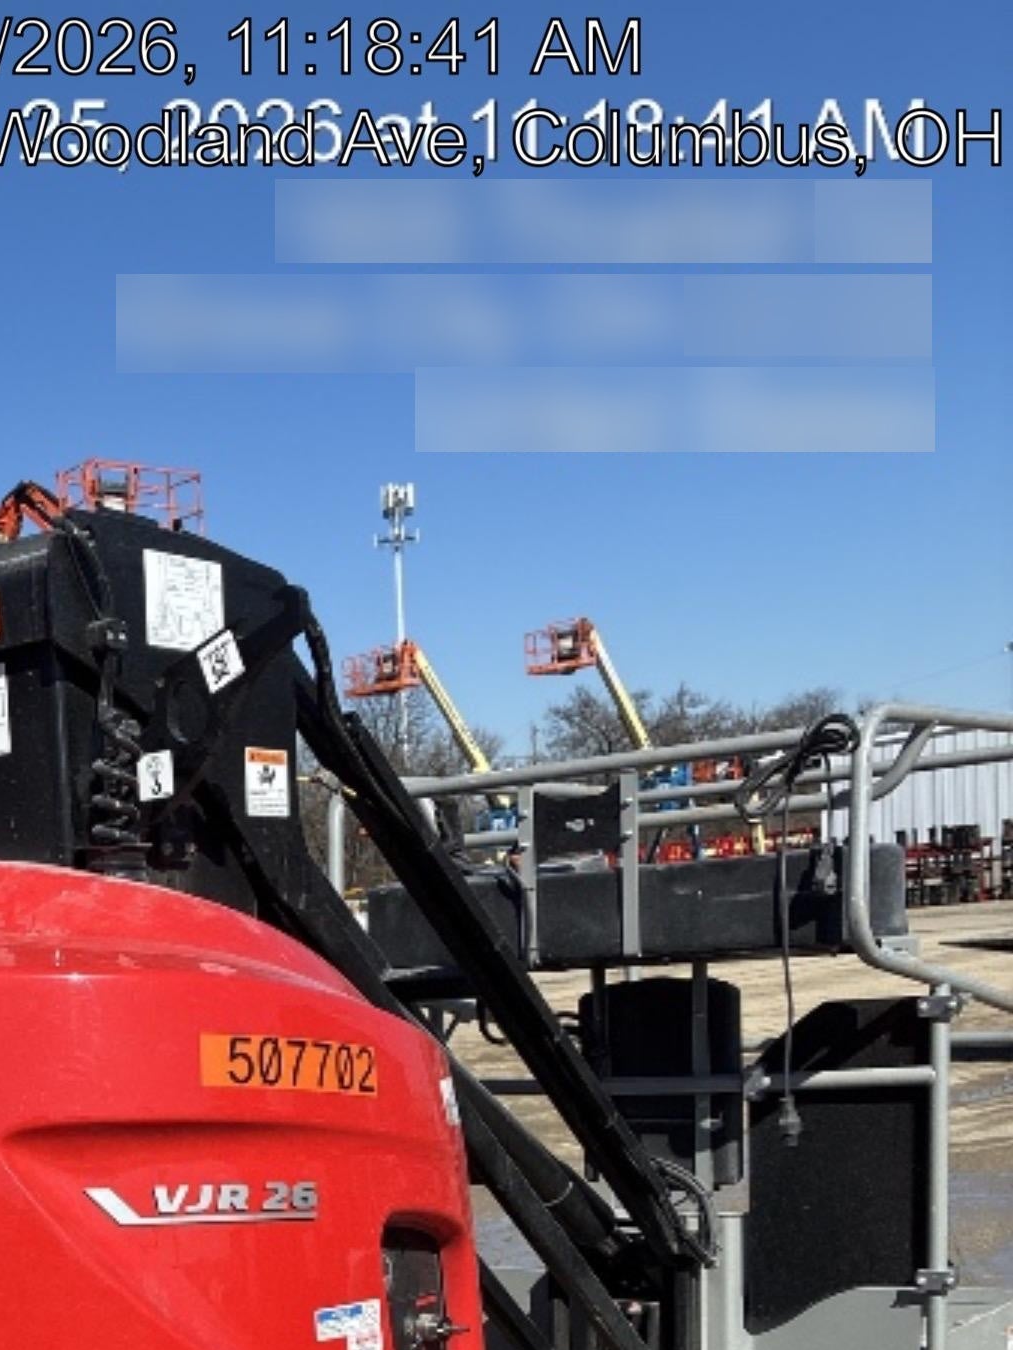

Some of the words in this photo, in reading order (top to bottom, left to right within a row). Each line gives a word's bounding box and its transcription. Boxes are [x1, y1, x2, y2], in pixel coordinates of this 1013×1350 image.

[228, 1037, 376, 1092] 507702
[153, 1184, 249, 1214] VJR
[261, 1181, 319, 1211] 26
